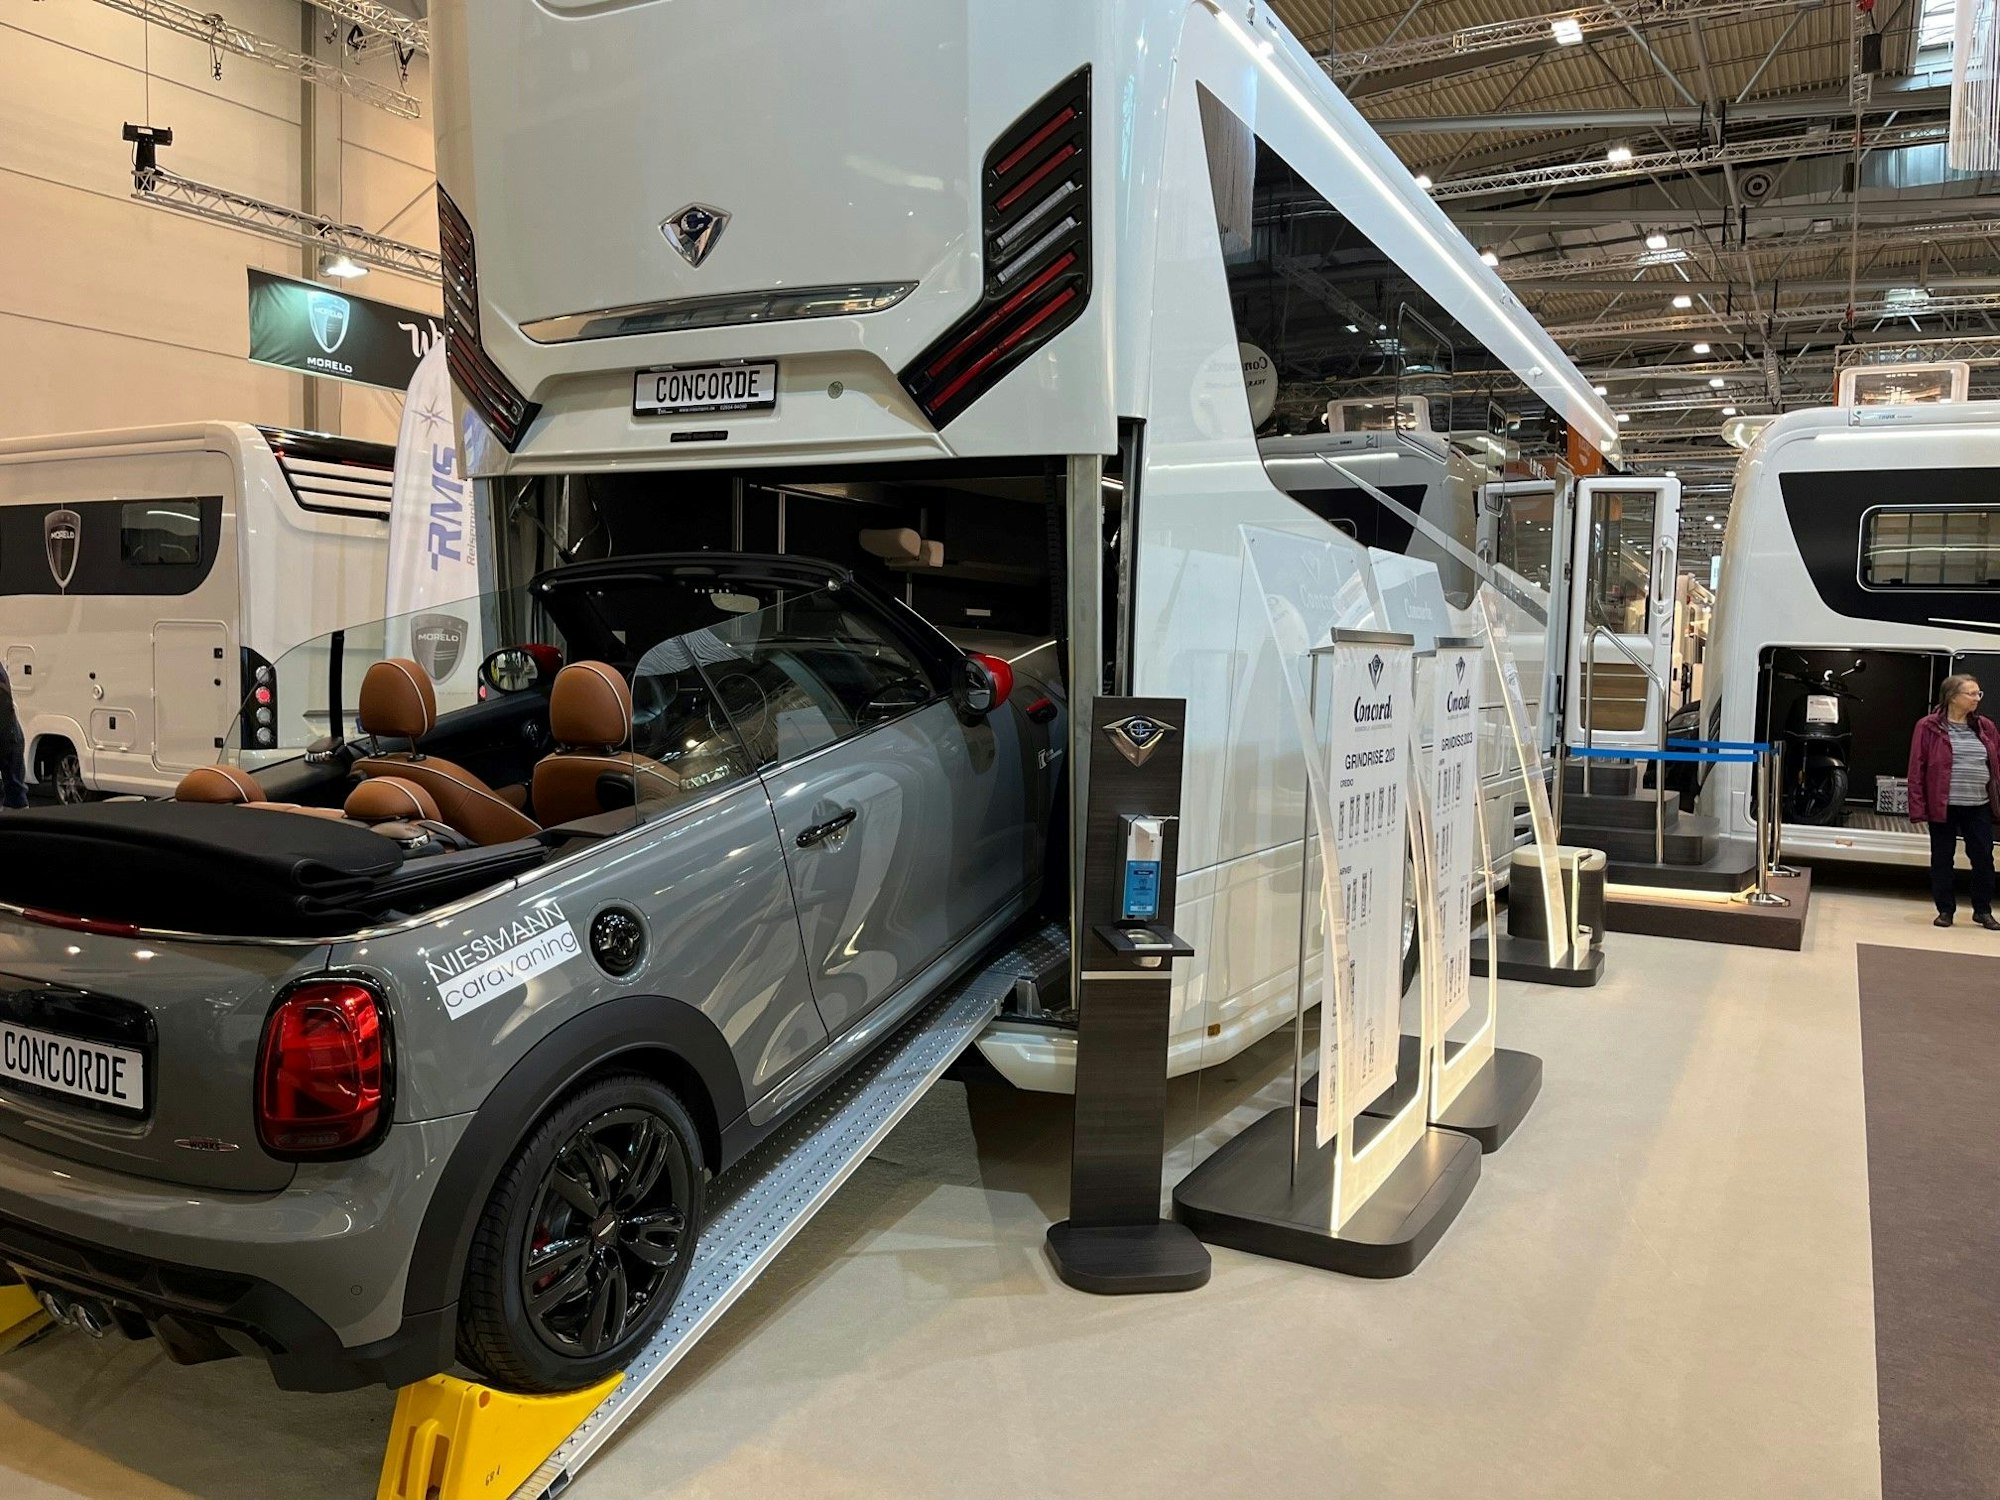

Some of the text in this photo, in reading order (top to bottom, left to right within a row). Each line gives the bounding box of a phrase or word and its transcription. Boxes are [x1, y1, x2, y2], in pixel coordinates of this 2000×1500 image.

[306, 356, 353, 374] MORELO
[655, 369, 761, 404] CONCORDE
[427, 443, 464, 571] RMS
[50, 530, 75, 540] MORELO
[417, 632, 459, 643] MORELO
[426, 901, 566, 984] NIESMANN
[444, 930, 578, 1008] caravaning
[4, 1031, 127, 1100] CONCORDE
